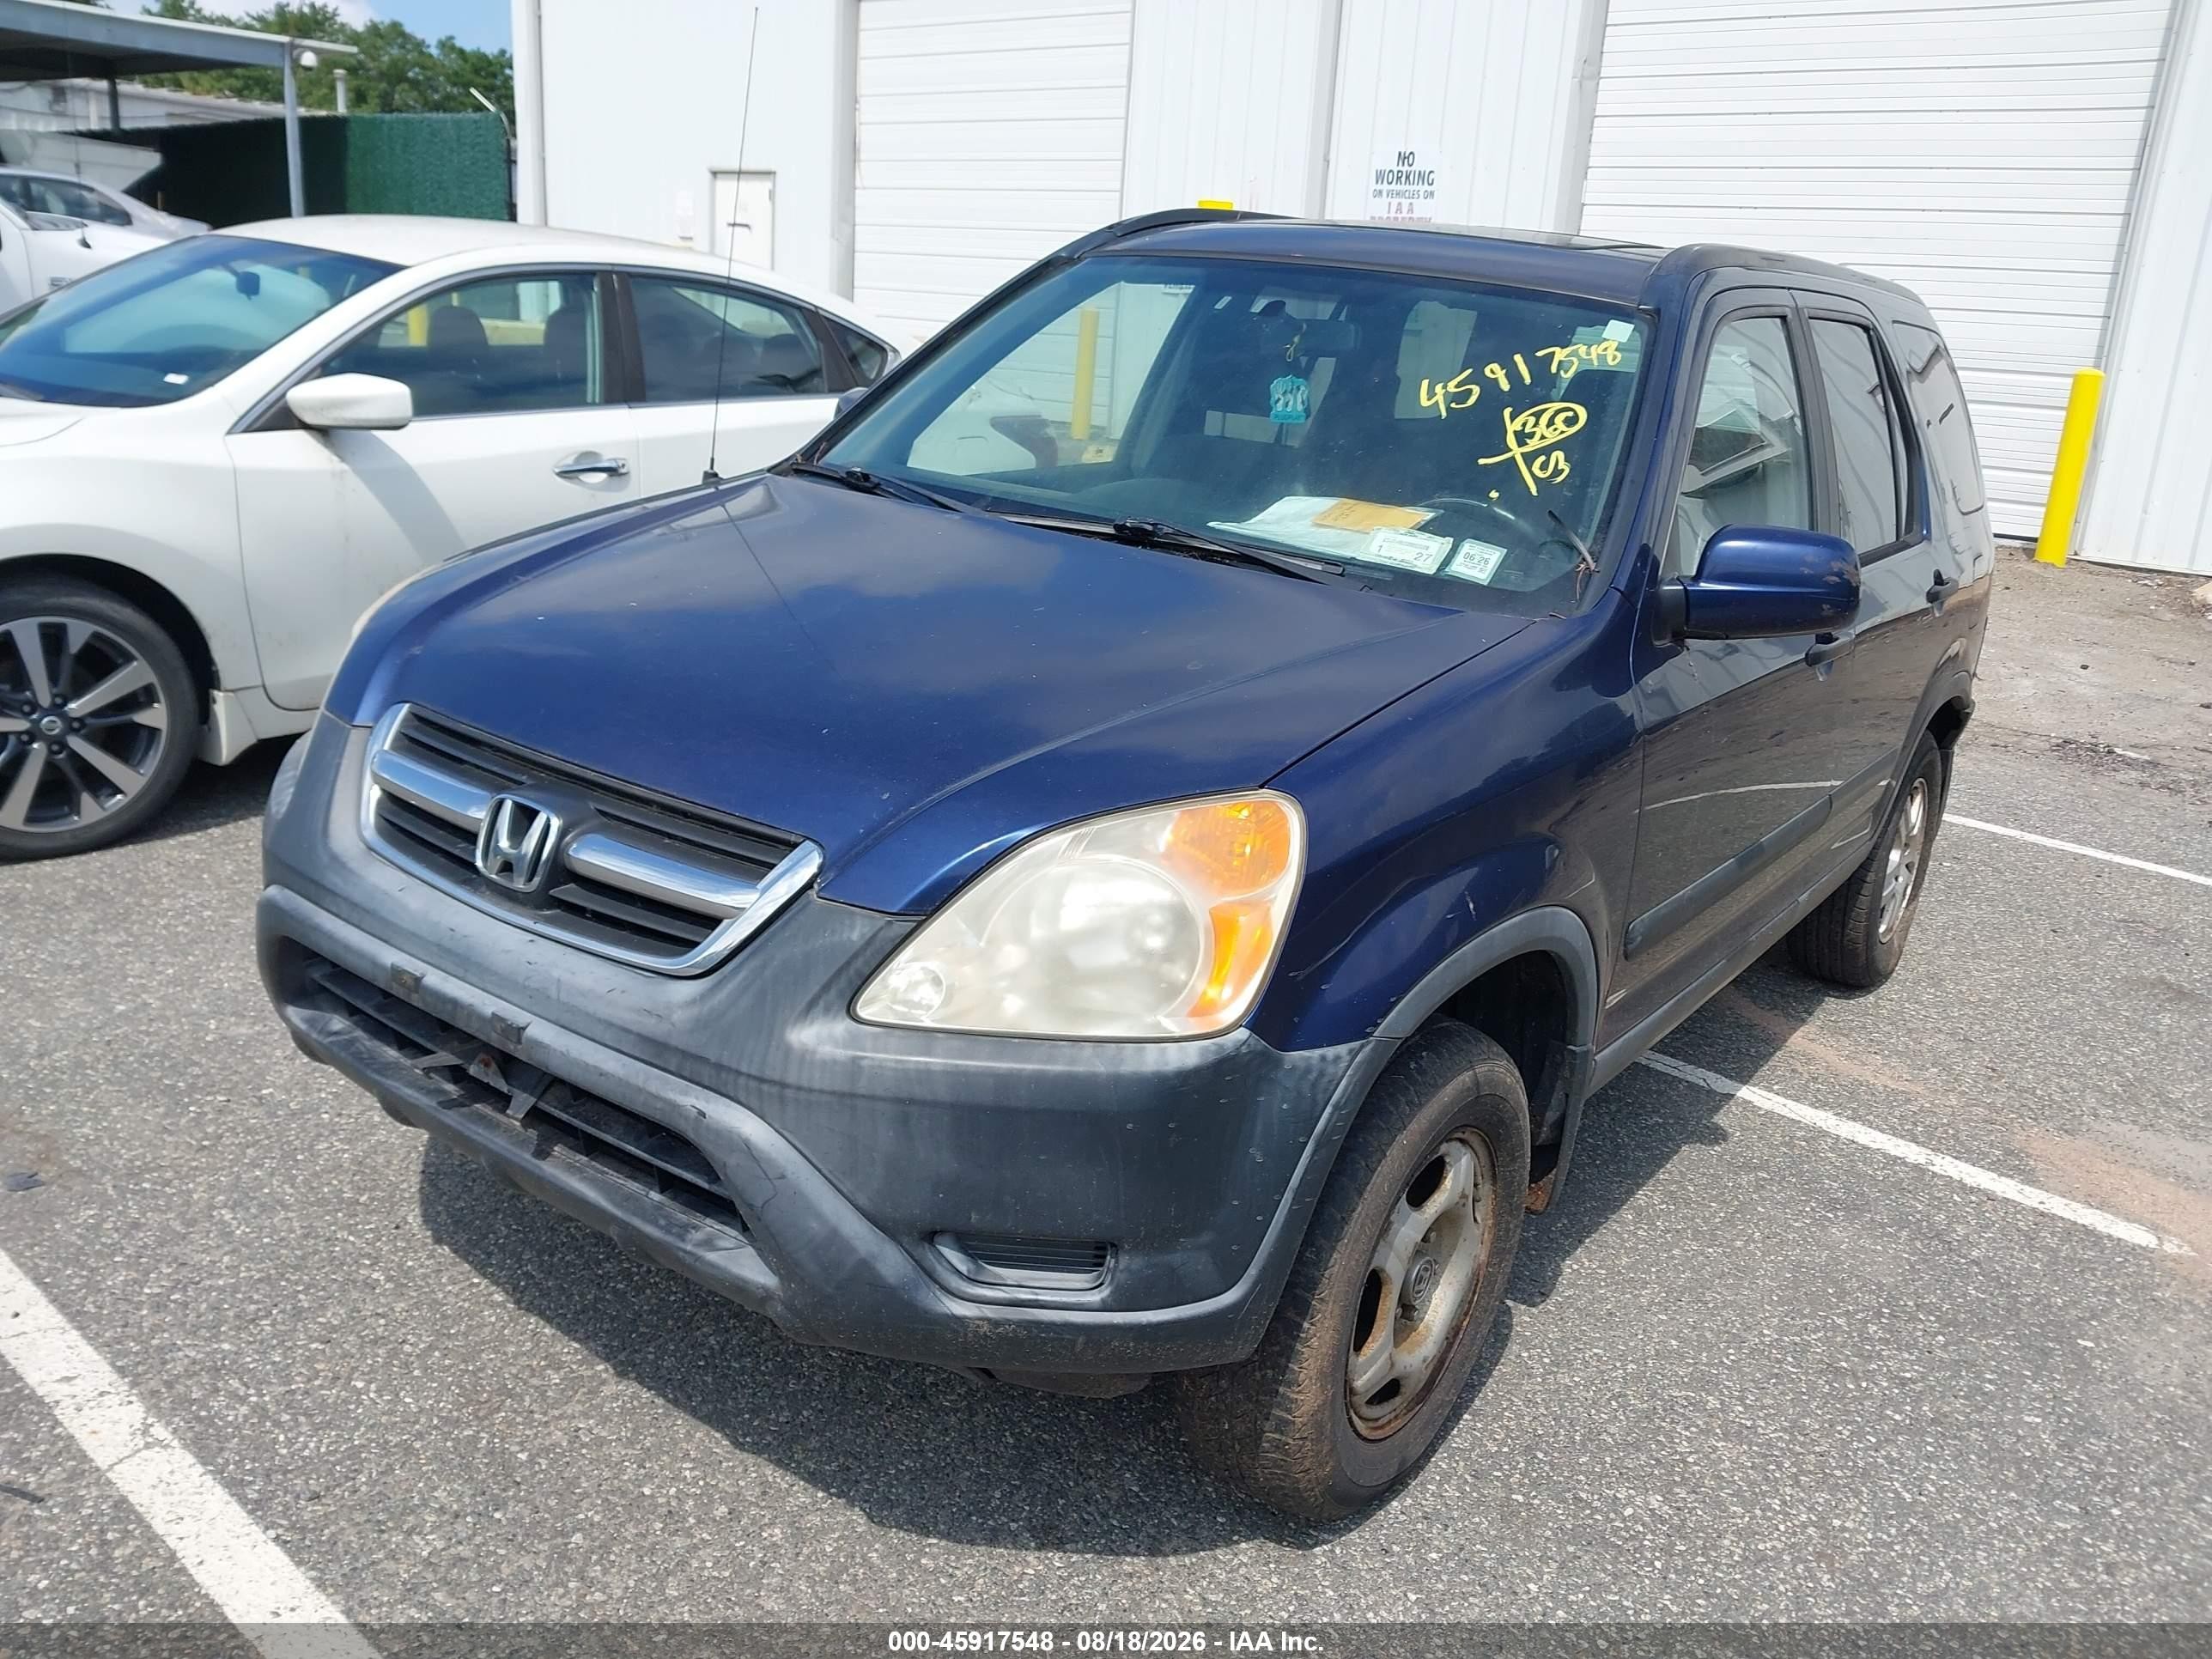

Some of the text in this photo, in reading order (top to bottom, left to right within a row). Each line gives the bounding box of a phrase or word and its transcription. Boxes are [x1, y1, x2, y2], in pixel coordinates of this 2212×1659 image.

[1396, 151, 1415, 167] NO
[1376, 169, 1435, 186] WORKING
[1373, 188, 1435, 200] ON VEHICLES ON
[1413, 551, 1433, 562] 27
